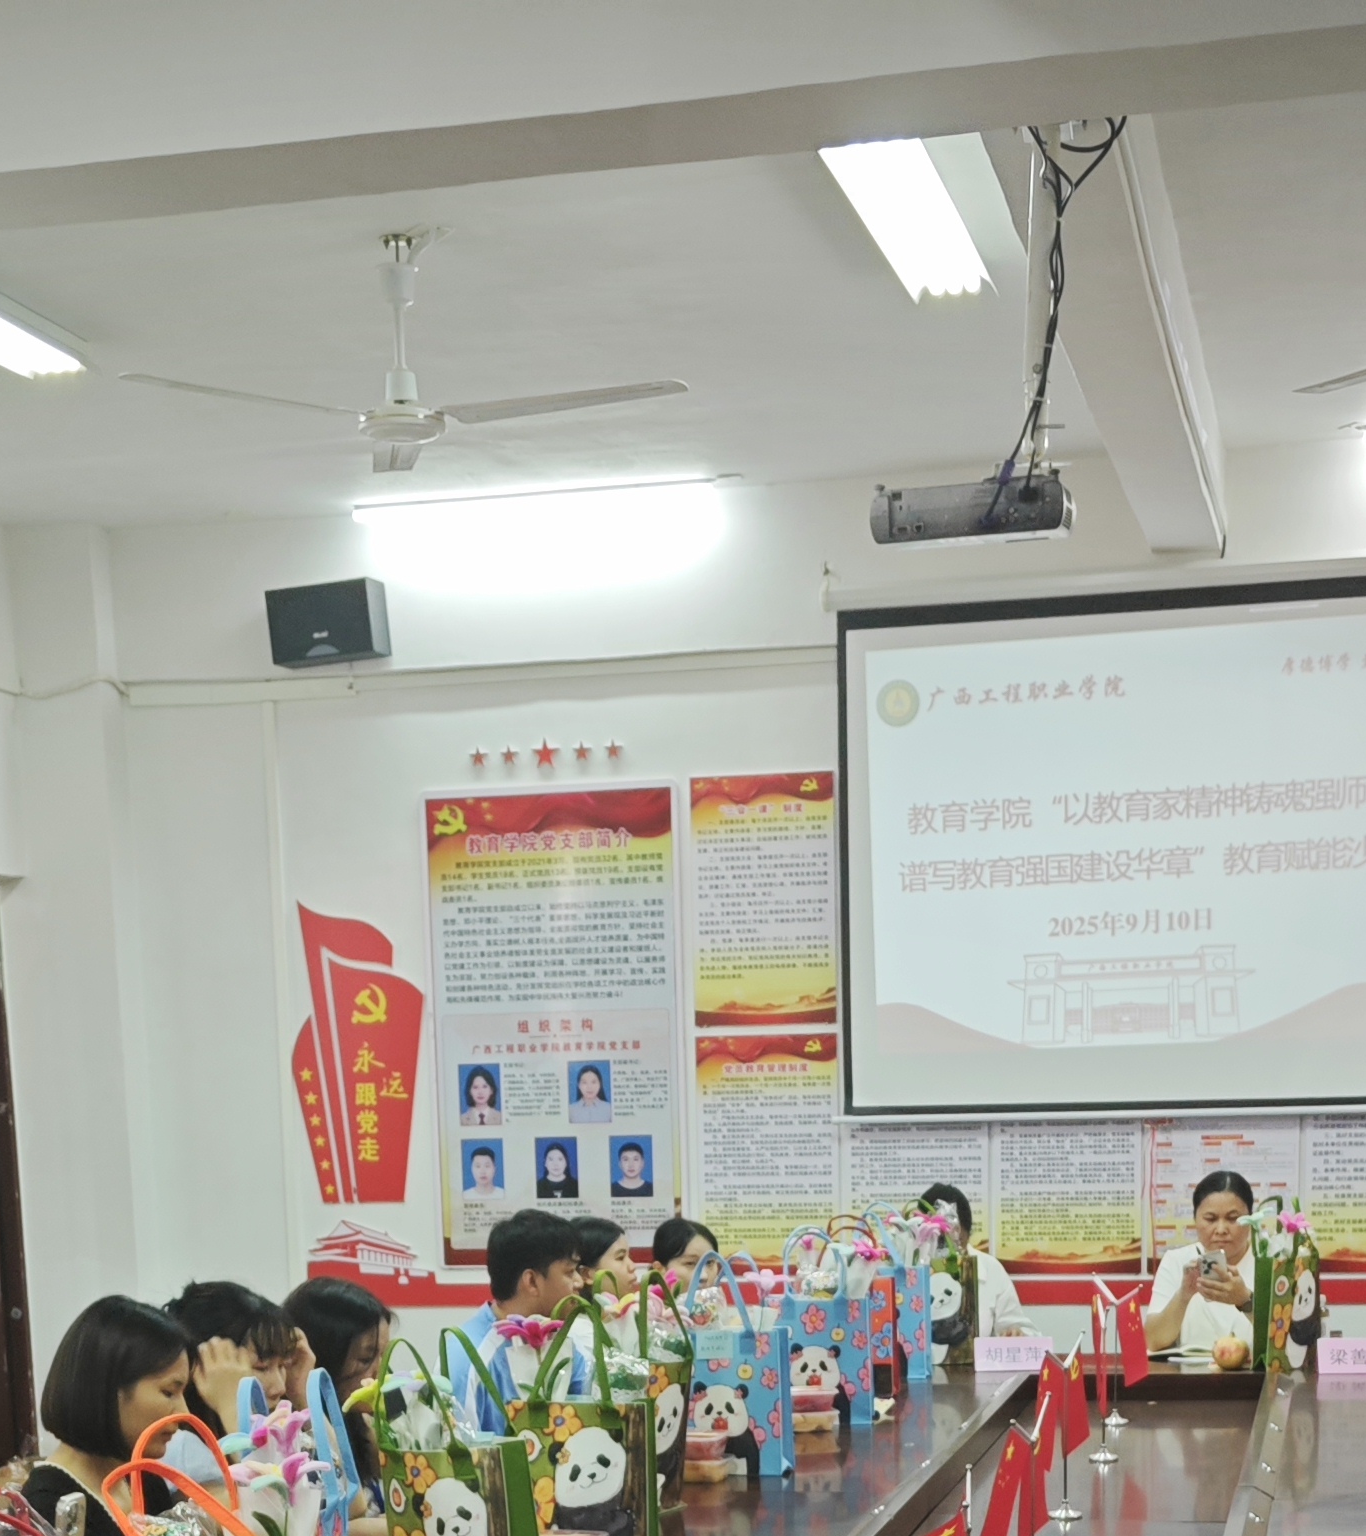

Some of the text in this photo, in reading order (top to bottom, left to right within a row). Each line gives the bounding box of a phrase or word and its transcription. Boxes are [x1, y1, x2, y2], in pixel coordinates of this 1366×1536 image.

[926, 675, 1127, 712] 广西工程职业学院
[466, 829, 632, 855] 教育学院党支部简介
[1048, 907, 1214, 937] 2025年9月10日
[517, 1018, 594, 1034] 组织架构
[472, 1040, 641, 1055] 广西工程职业学院教育学院党支部
[352, 1041, 409, 1162] 永远跟党走
[985, 1346, 1043, 1363] 胡星萍
